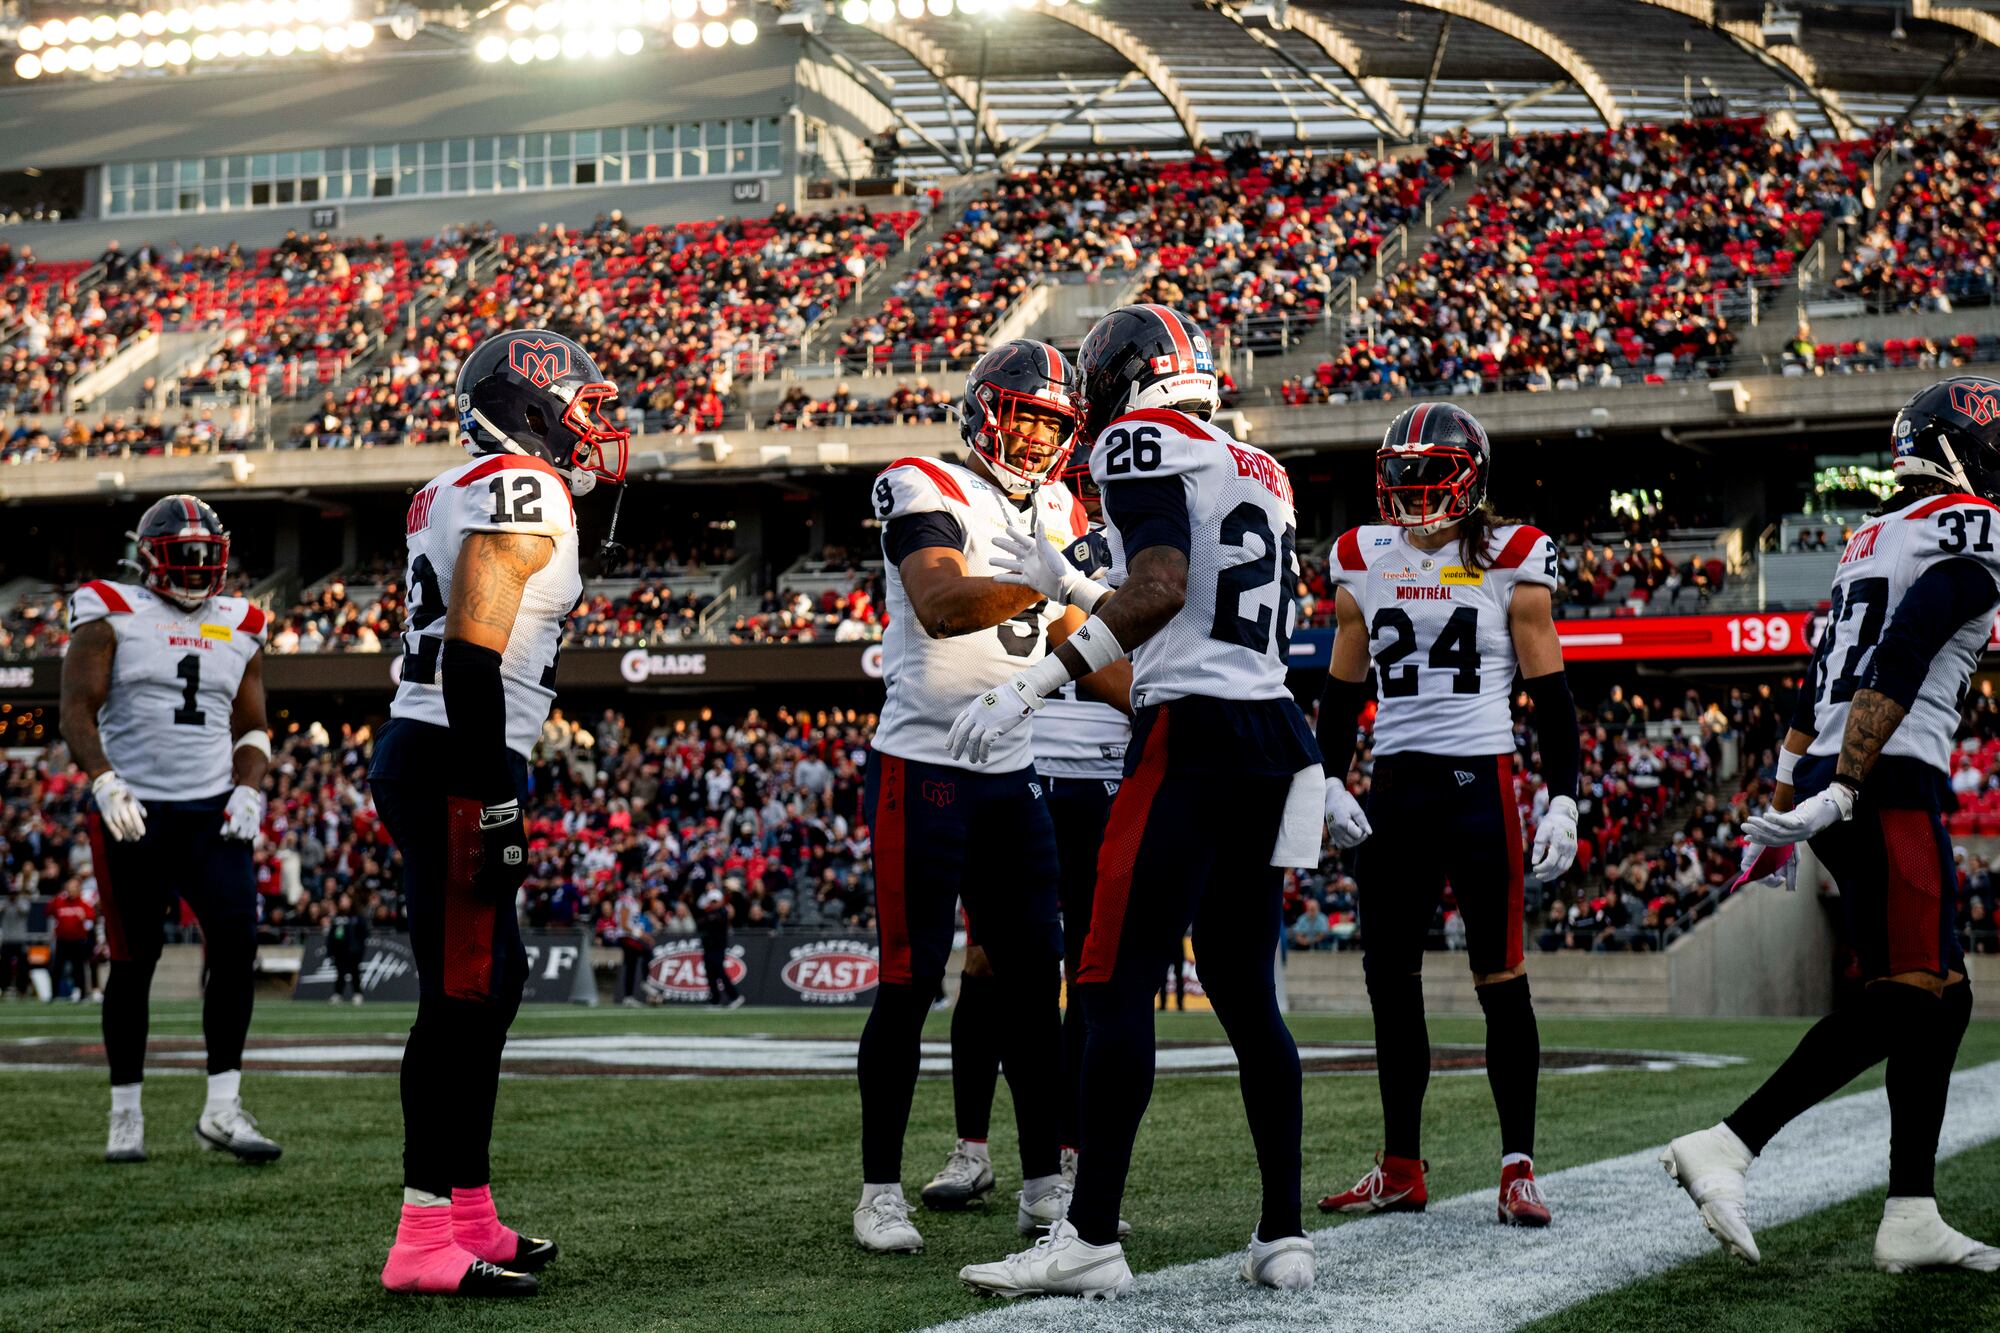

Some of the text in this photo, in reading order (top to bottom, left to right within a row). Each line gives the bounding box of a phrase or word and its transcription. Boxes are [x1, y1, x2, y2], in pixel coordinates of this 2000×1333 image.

[734, 183, 760, 199] UU
[314, 210, 333, 226] TT
[1171, 378, 1210, 387] ALOUETTES
[1105, 426, 1162, 475] 26
[489, 476, 543, 523] 12
[876, 477, 896, 516] 9
[1937, 509, 1994, 553] 37
[1382, 571, 1418, 579] Freedom
[1396, 584, 1452, 600] MONTRÉAL
[1727, 616, 1791, 651] 139
[1370, 606, 1482, 698] 24
[174, 655, 206, 725] 1
[797, 961, 872, 988] FAST
